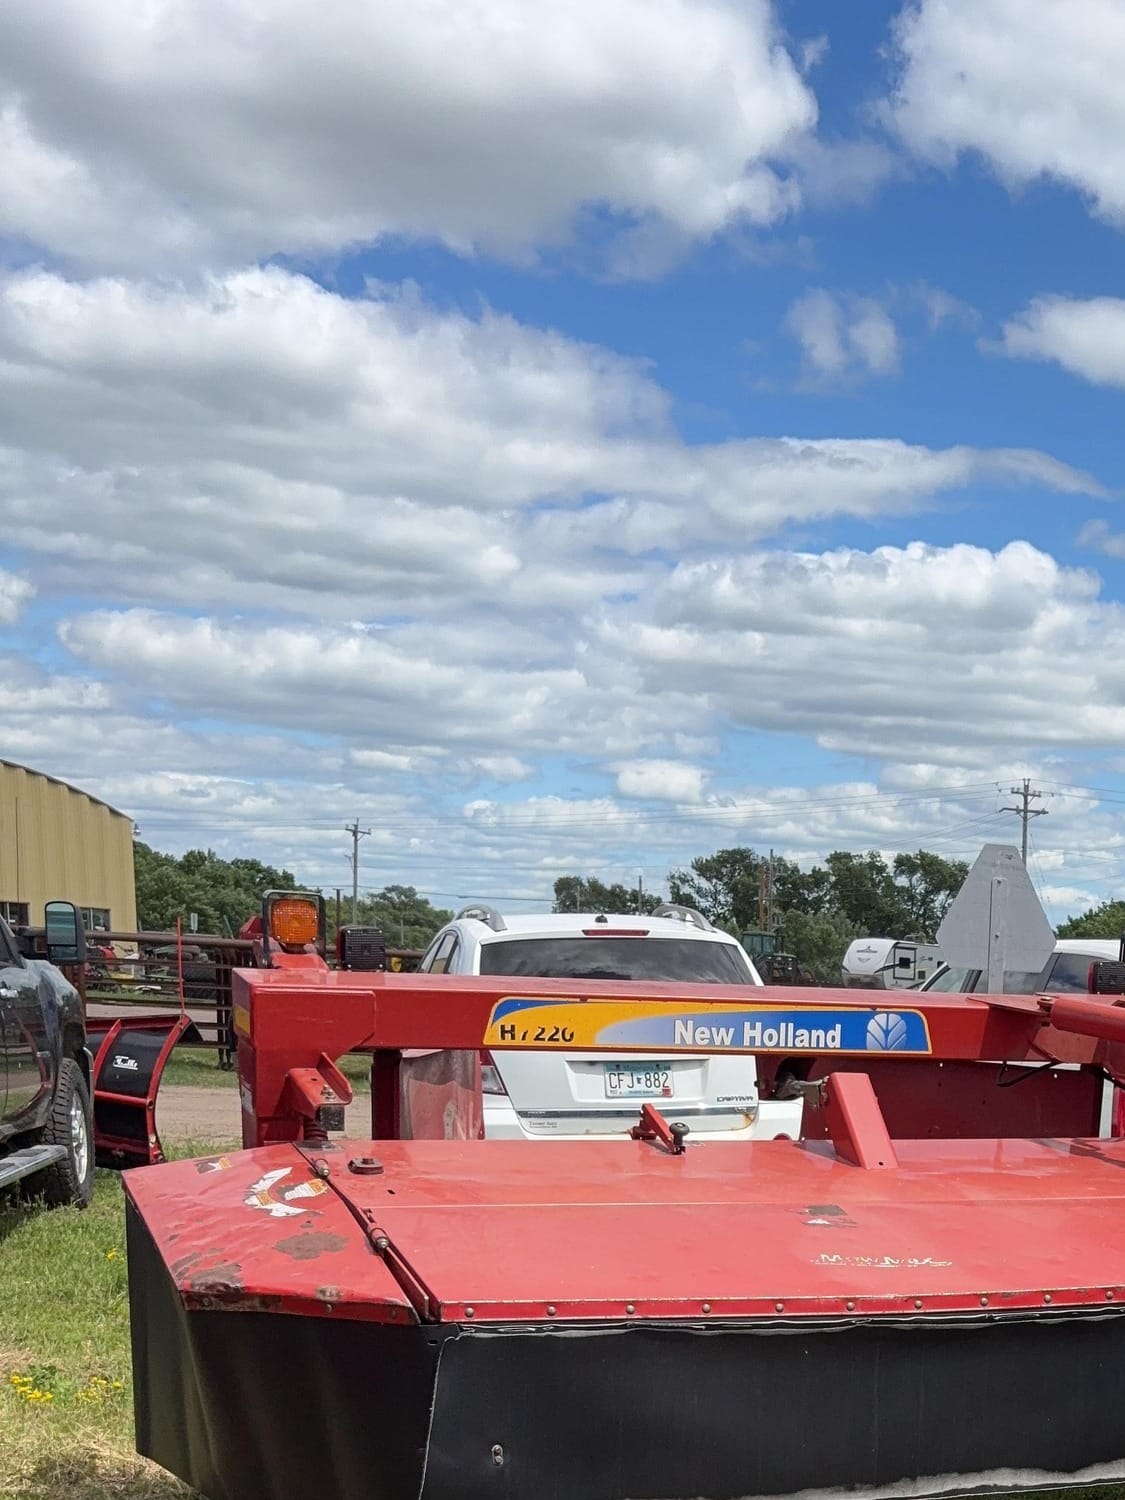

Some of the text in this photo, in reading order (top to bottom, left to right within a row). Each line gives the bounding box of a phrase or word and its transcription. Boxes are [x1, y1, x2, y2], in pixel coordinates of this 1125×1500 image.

[673, 1019, 842, 1049] New Holland
[608, 1071, 670, 1089] CFJ 882
